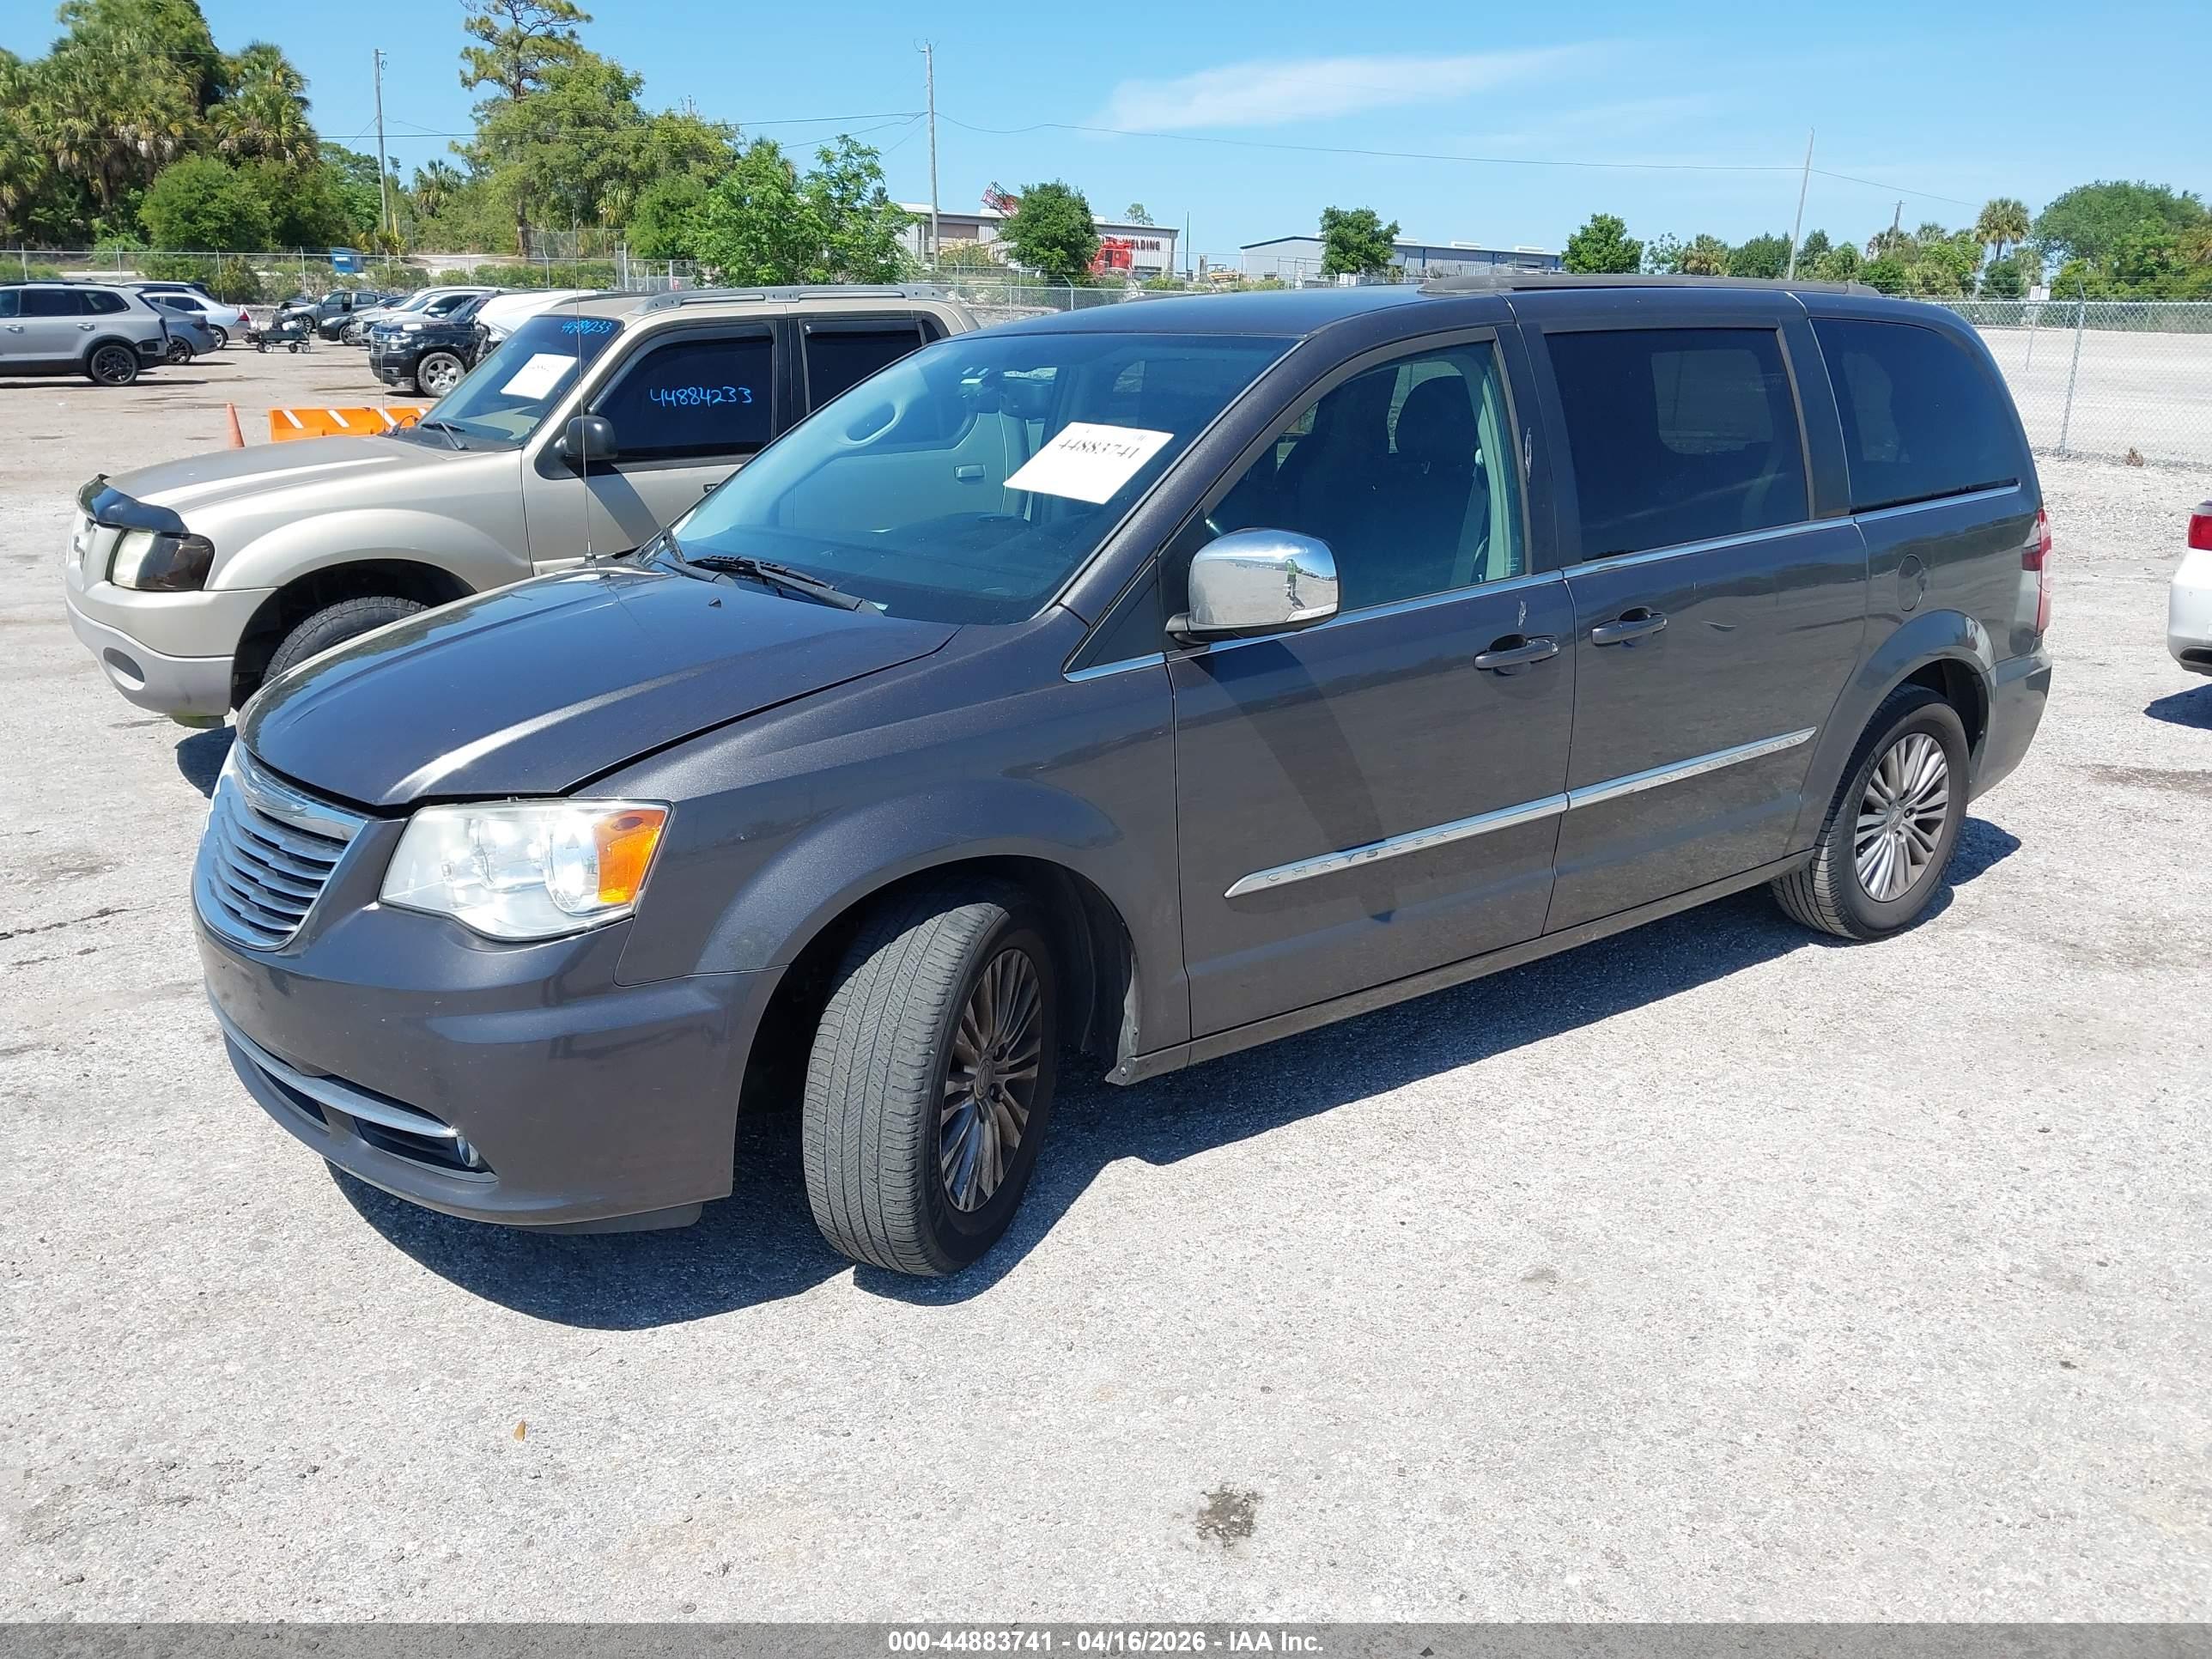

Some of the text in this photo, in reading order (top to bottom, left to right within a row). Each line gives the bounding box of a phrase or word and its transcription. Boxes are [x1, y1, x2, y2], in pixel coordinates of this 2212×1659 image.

[650, 386, 752, 407] 44884233
[1059, 439, 1139, 459] 44883741
[1267, 831, 1448, 882] CHRYSLER
